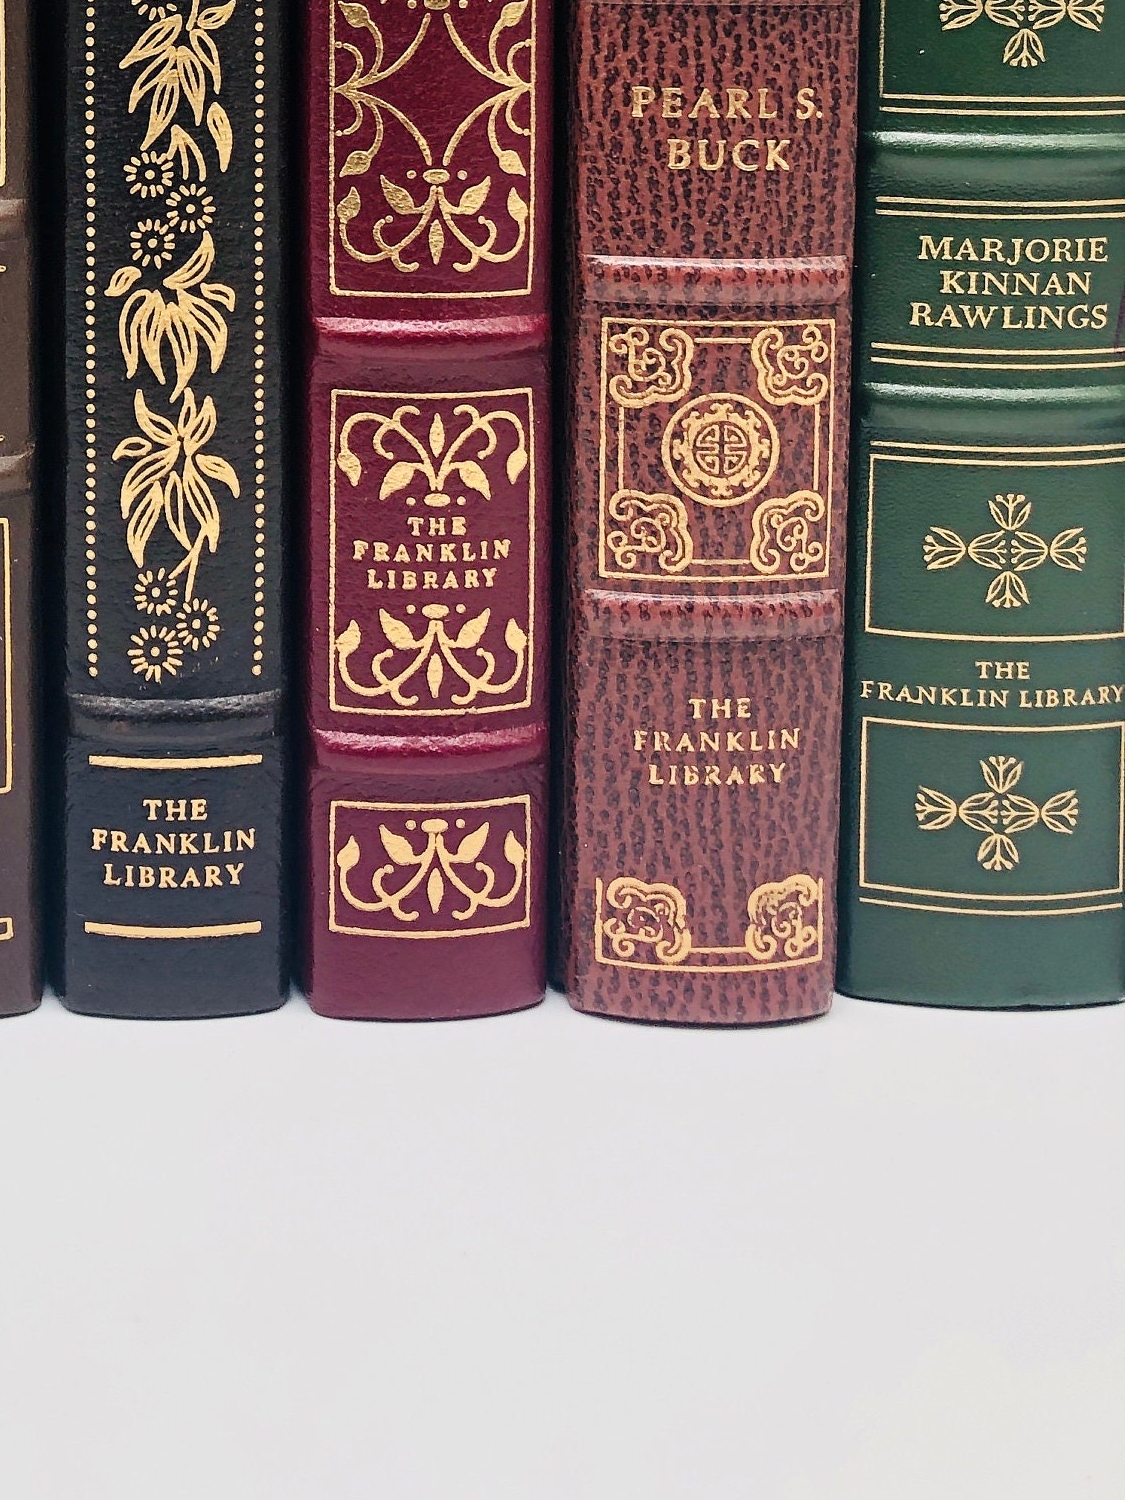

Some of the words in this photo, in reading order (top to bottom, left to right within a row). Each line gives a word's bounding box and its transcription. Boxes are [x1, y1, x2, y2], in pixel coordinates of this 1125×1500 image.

[631, 85, 778, 119] PEARL
[795, 87, 825, 120] S.
[666, 138, 791, 172] BUCK
[917, 235, 1109, 266] MARJORIE
[939, 270, 1092, 297] KINNAN
[909, 302, 1108, 330] RAWLINGS
[406, 516, 467, 537] THE
[352, 538, 511, 564] FRANKLIN
[367, 567, 498, 590] LIBRARY
[974, 661, 1031, 680] THE
[859, 680, 1010, 709] FRANKLIN
[1018, 684, 1125, 708] LIBRARY
[688, 697, 752, 720] THE
[633, 727, 801, 753] FRANKLIN
[648, 762, 786, 786] LIBRARY
[142, 798, 208, 822] THE
[91, 827, 256, 855] FRANKLIN
[103, 862, 244, 889] LIBRARY
